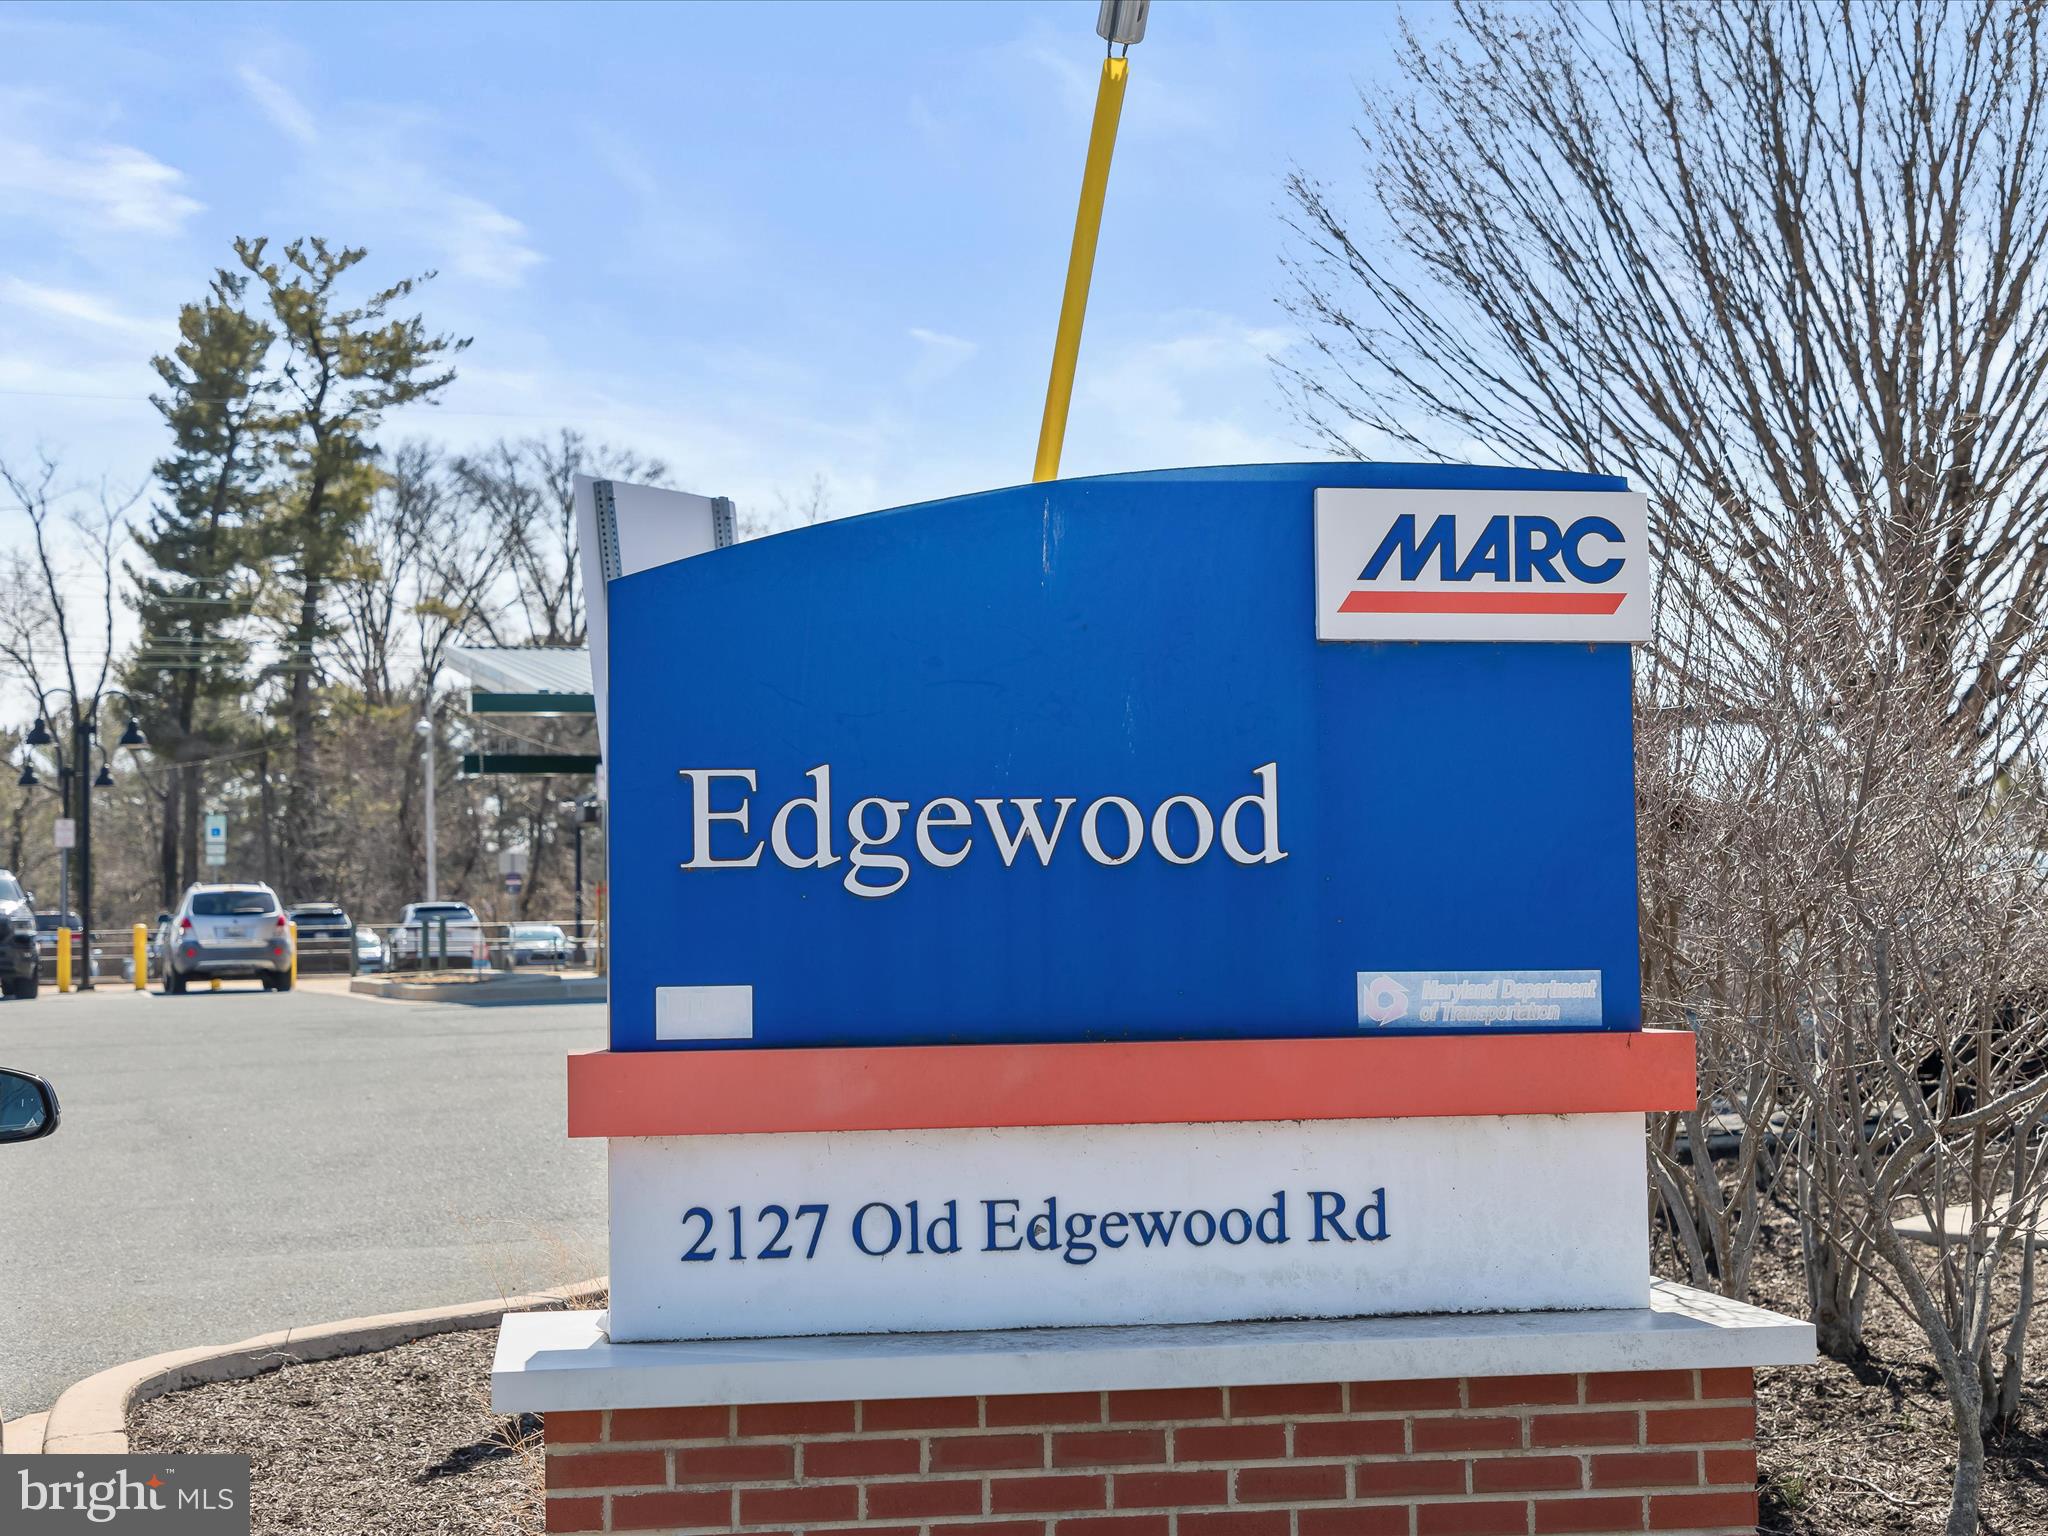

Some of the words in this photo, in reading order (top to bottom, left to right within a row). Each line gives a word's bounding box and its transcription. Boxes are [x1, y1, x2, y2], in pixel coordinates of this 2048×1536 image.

[1357, 513, 1626, 584] MARC
[679, 761, 1289, 898] Edgewood
[1420, 1004, 1440, 1021] of
[1440, 1003, 1560, 1025] Transportation
[1422, 980, 1498, 1003] Maryland
[1501, 979, 1597, 1002] Department
[681, 1202, 829, 1262] 2127
[852, 1200, 962, 1256] Old
[980, 1190, 1290, 1265] Edgewood
[1307, 1187, 1391, 1243] Rd
